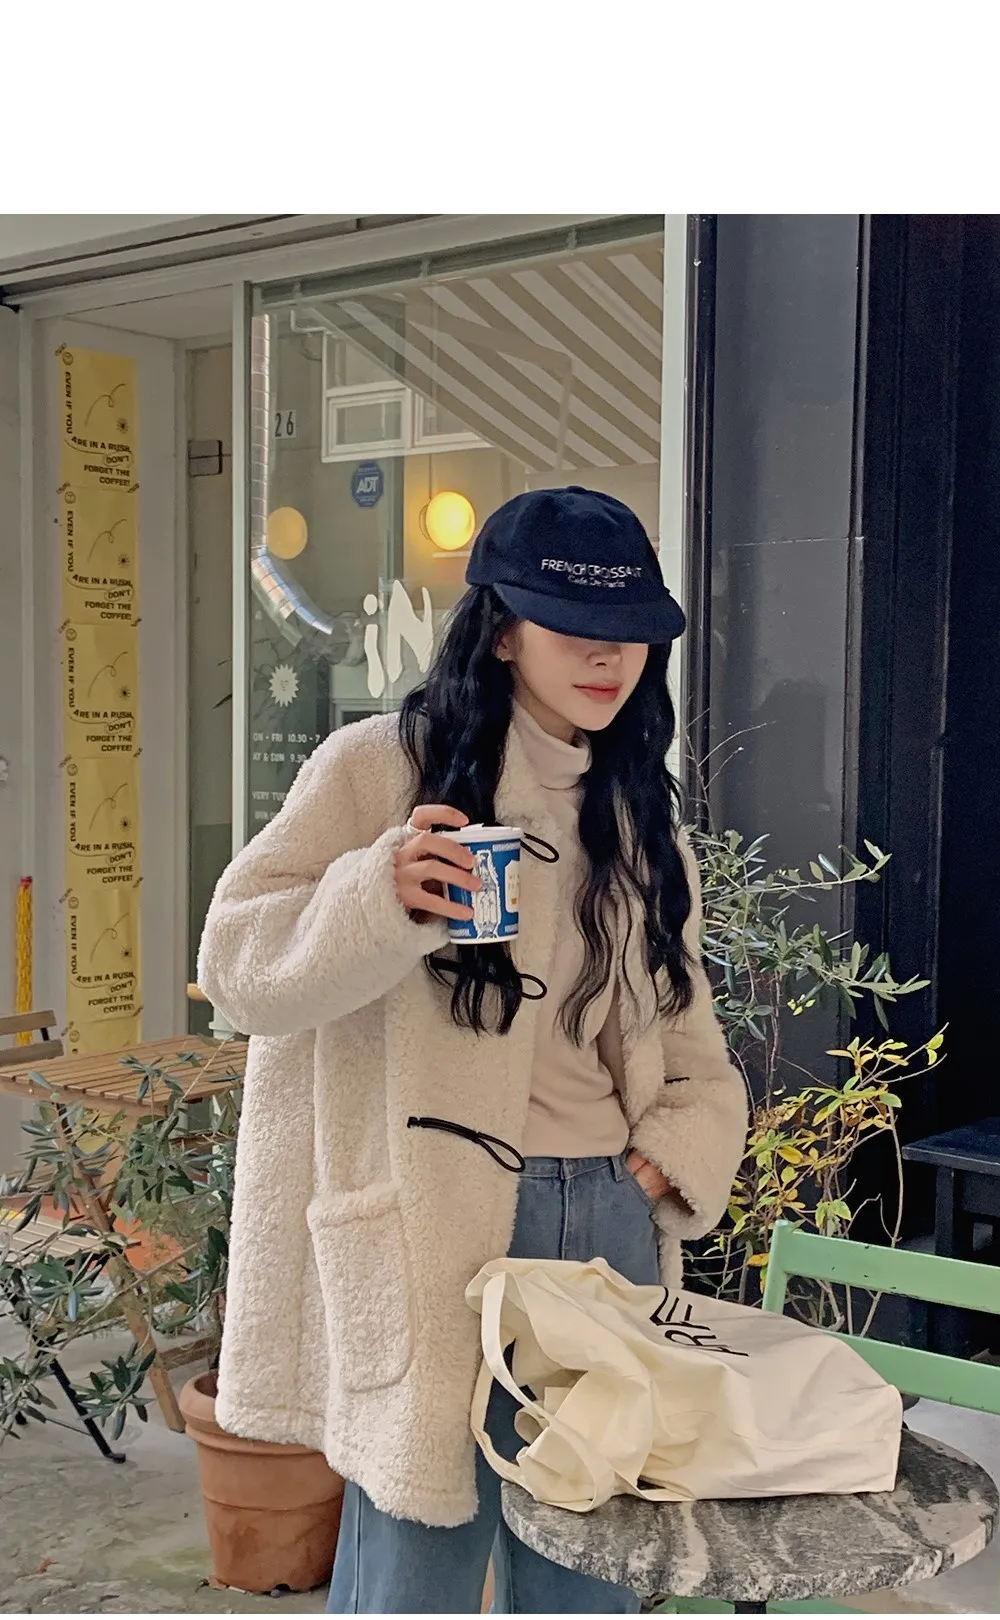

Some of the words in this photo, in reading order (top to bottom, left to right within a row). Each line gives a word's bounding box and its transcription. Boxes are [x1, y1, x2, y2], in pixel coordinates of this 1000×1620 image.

[66, 401, 72, 410] IF
[275, 411, 295, 437] 26
[71, 436, 87, 447] ARE
[90, 441, 99, 450] IN
[100, 442, 107, 450] A
[84, 464, 113, 475] FORGET
[116, 468, 130, 477] THE
[356, 476, 380, 494] ADT
[67, 539, 74, 548] IF
[541, 559, 586, 575] FRENCH
[72, 574, 89, 584] ARE
[84, 601, 115, 610] FORGET
[68, 676, 75, 685] IF
[73, 709, 90, 718] ARE
[271, 733, 284, 742] FRI
[270, 753, 285, 762] SUN
[70, 810, 76, 819] IF
[74, 843, 90, 851] ARE
[93, 842, 102, 850] IN
[104, 842, 110, 850] A
[86, 866, 116, 875] FORGET
[118, 865, 133, 873] THE
[70, 943, 77, 951] IF
[70, 956, 78, 975] YOU
[76, 975, 92, 983] ARE
[94, 974, 103, 982] IN
[88, 996, 118, 1006] FORGET
